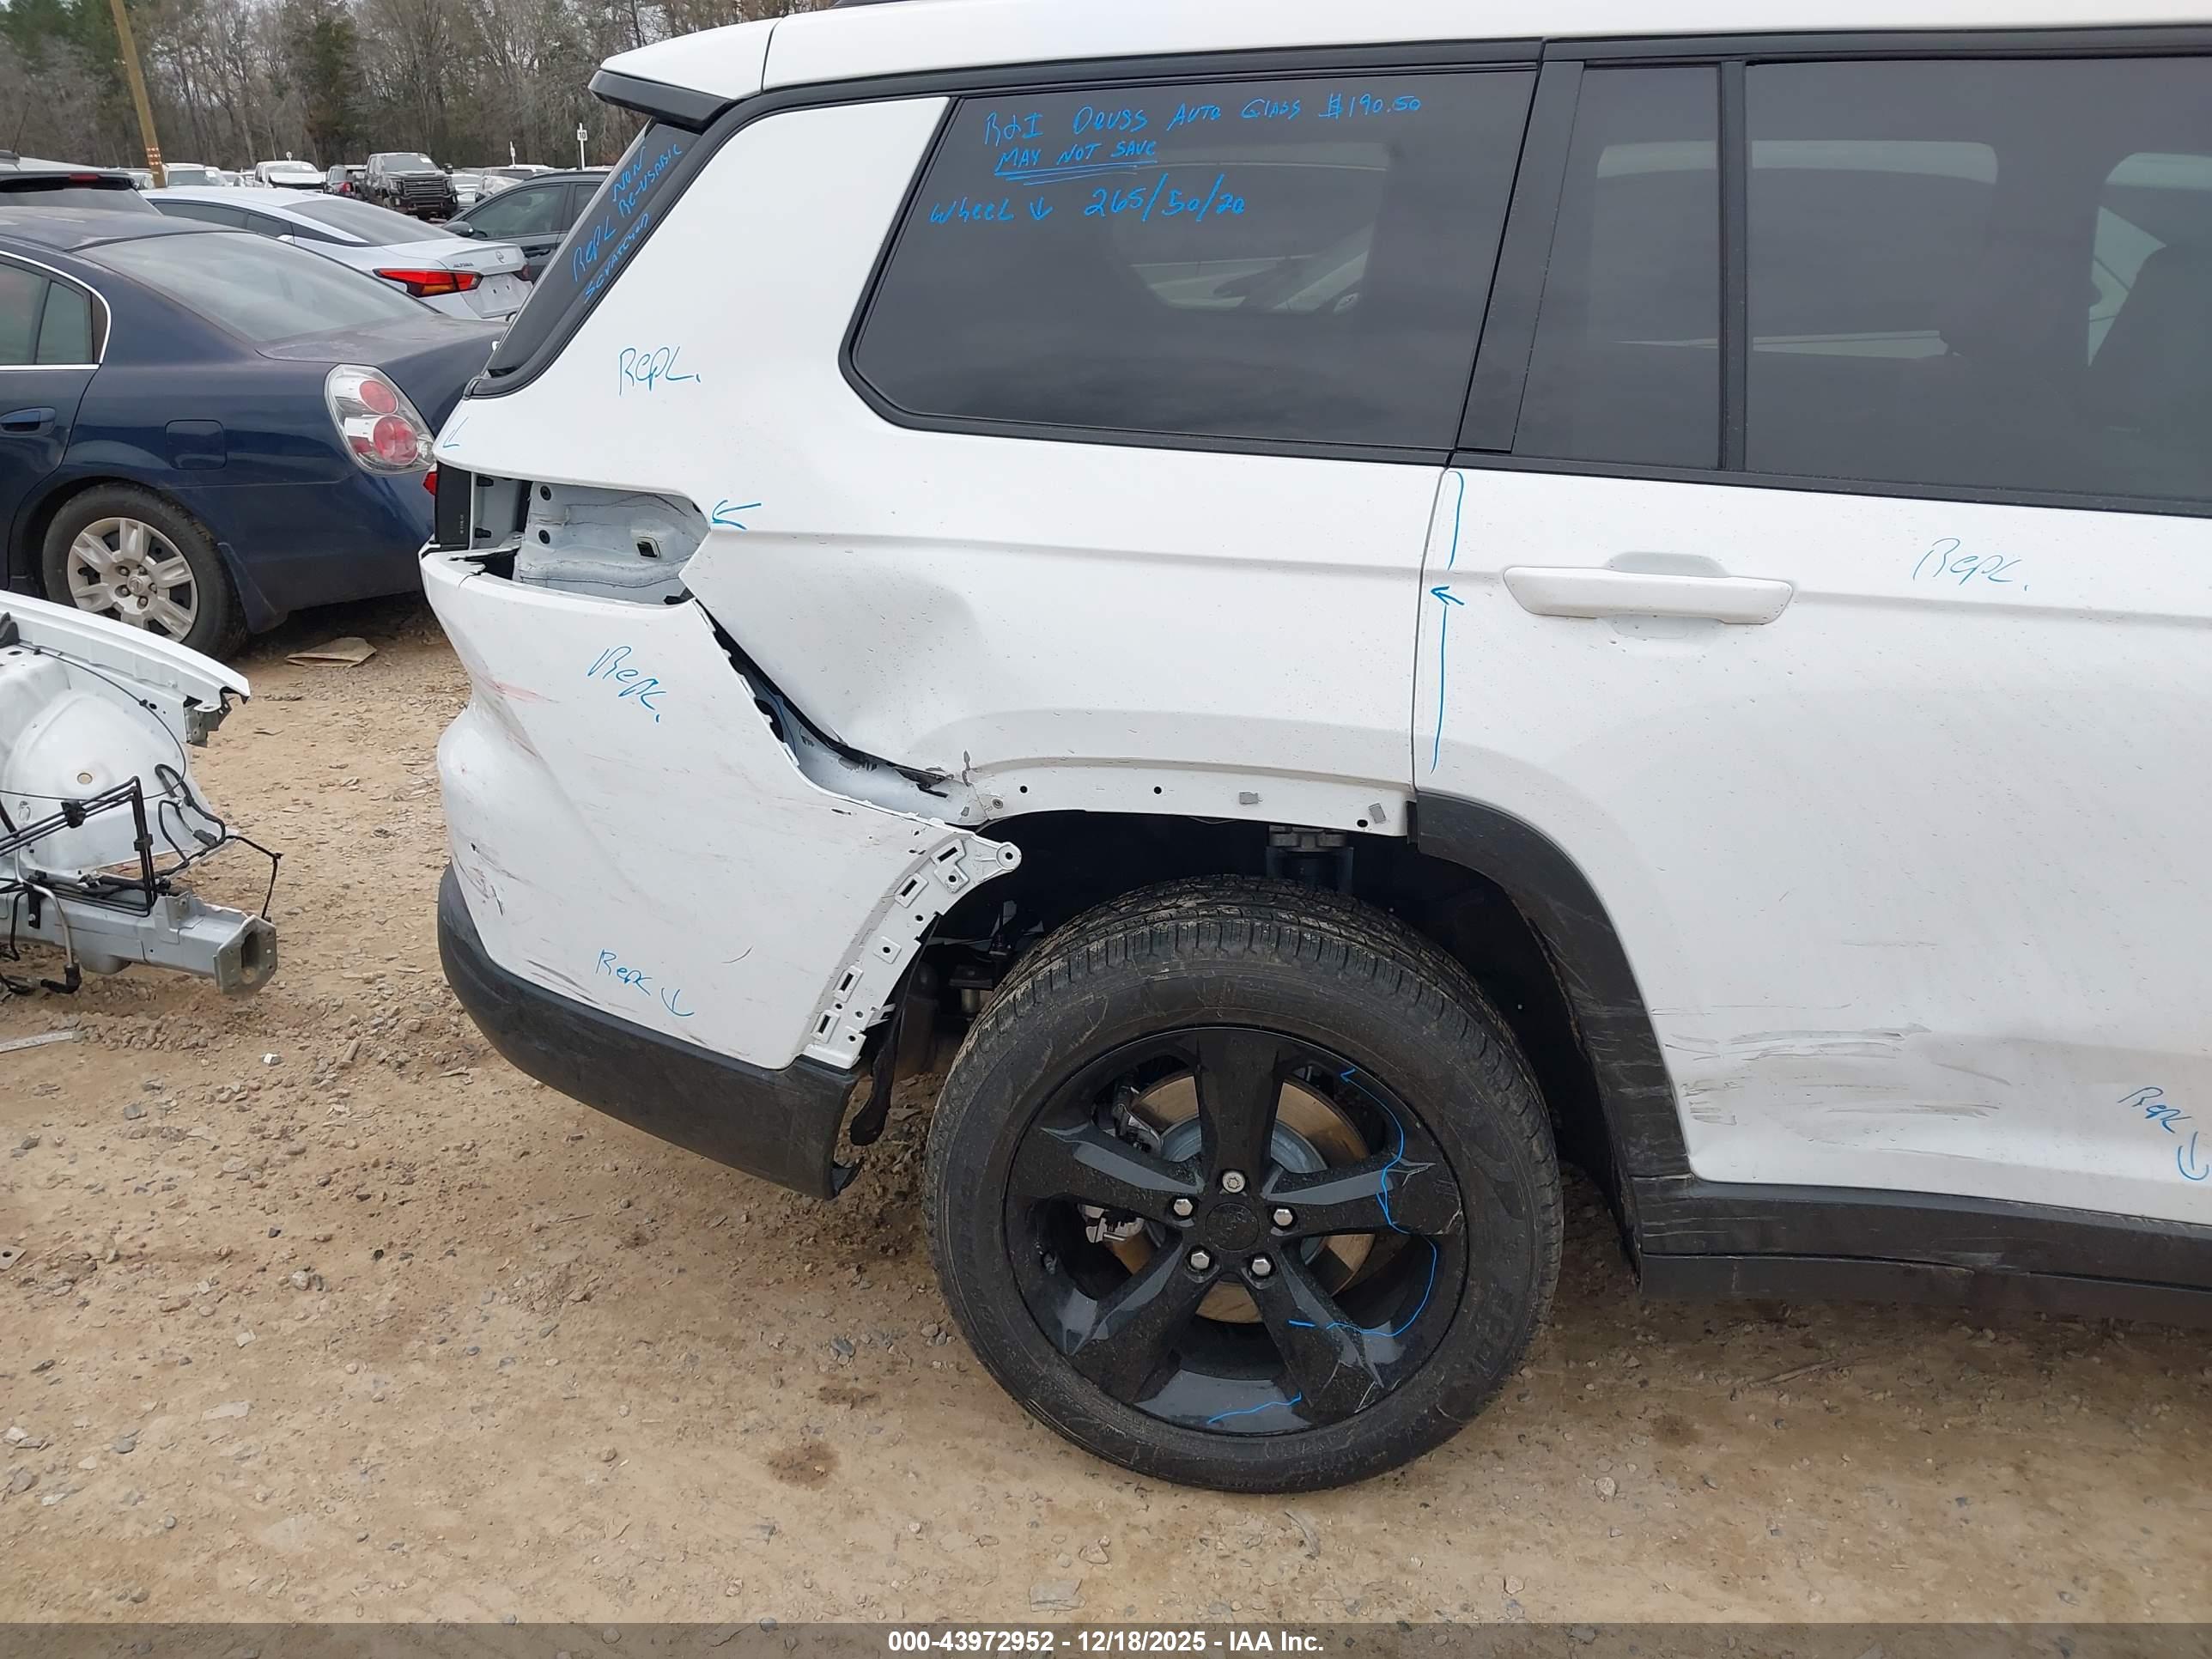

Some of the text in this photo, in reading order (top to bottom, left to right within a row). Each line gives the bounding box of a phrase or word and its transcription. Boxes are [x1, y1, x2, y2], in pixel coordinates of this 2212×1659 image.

[1166, 102, 1222, 132] AUTO
[1318, 92, 1422, 120] $190.50
[995, 139, 1157, 173] MAY NOT SAVE
[1083, 172, 1246, 223] 265/50/20
